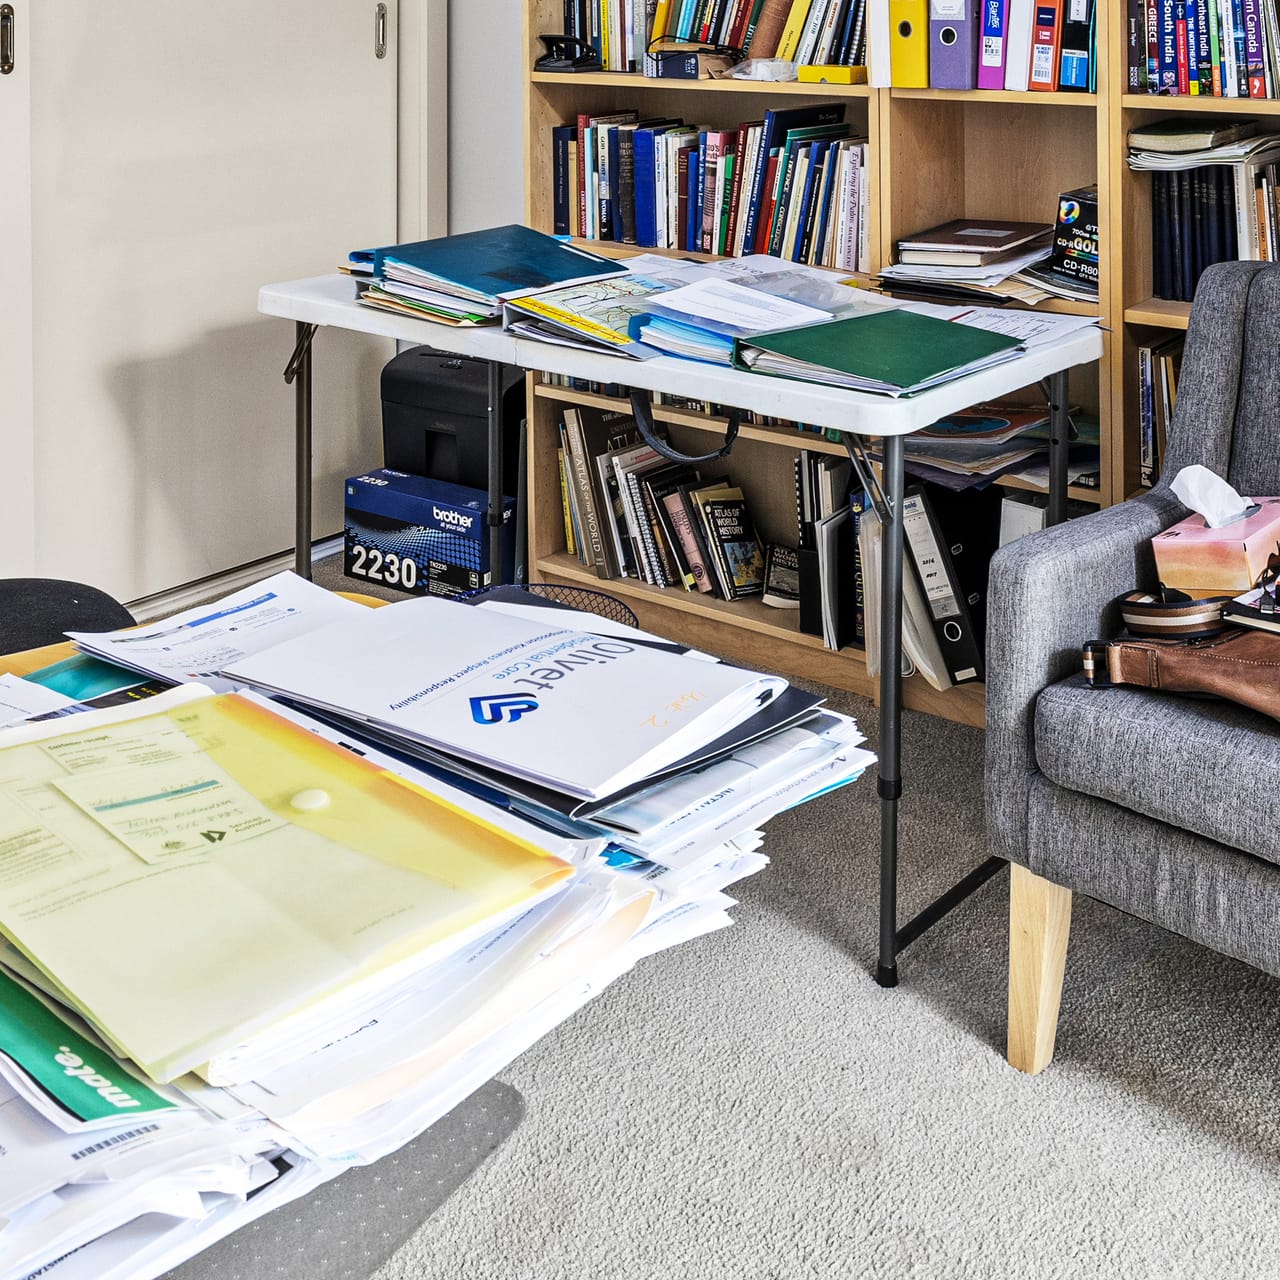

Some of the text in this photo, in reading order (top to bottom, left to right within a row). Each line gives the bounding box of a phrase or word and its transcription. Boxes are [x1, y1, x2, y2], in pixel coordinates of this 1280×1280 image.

[1147, 7, 1157, 42] GREECE
[1163, 0, 1175, 62] South India
[1245, 14, 1259, 52] Canada
[1186, 17, 1197, 70] THE NORTHEAST
[1199, 33, 1210, 56] India
[432, 506, 473, 528] brother
[575, 457, 601, 552] ATLAS WORLD
[714, 509, 732, 517] ATLAS
[718, 518, 738, 526] WORLD
[446, 524, 456, 532] your
[720, 526, 744, 534] HISTORY
[352, 545, 417, 589] 2230
[514, 641, 635, 690] Olivet
[388, 674, 456, 712] Responsibility
